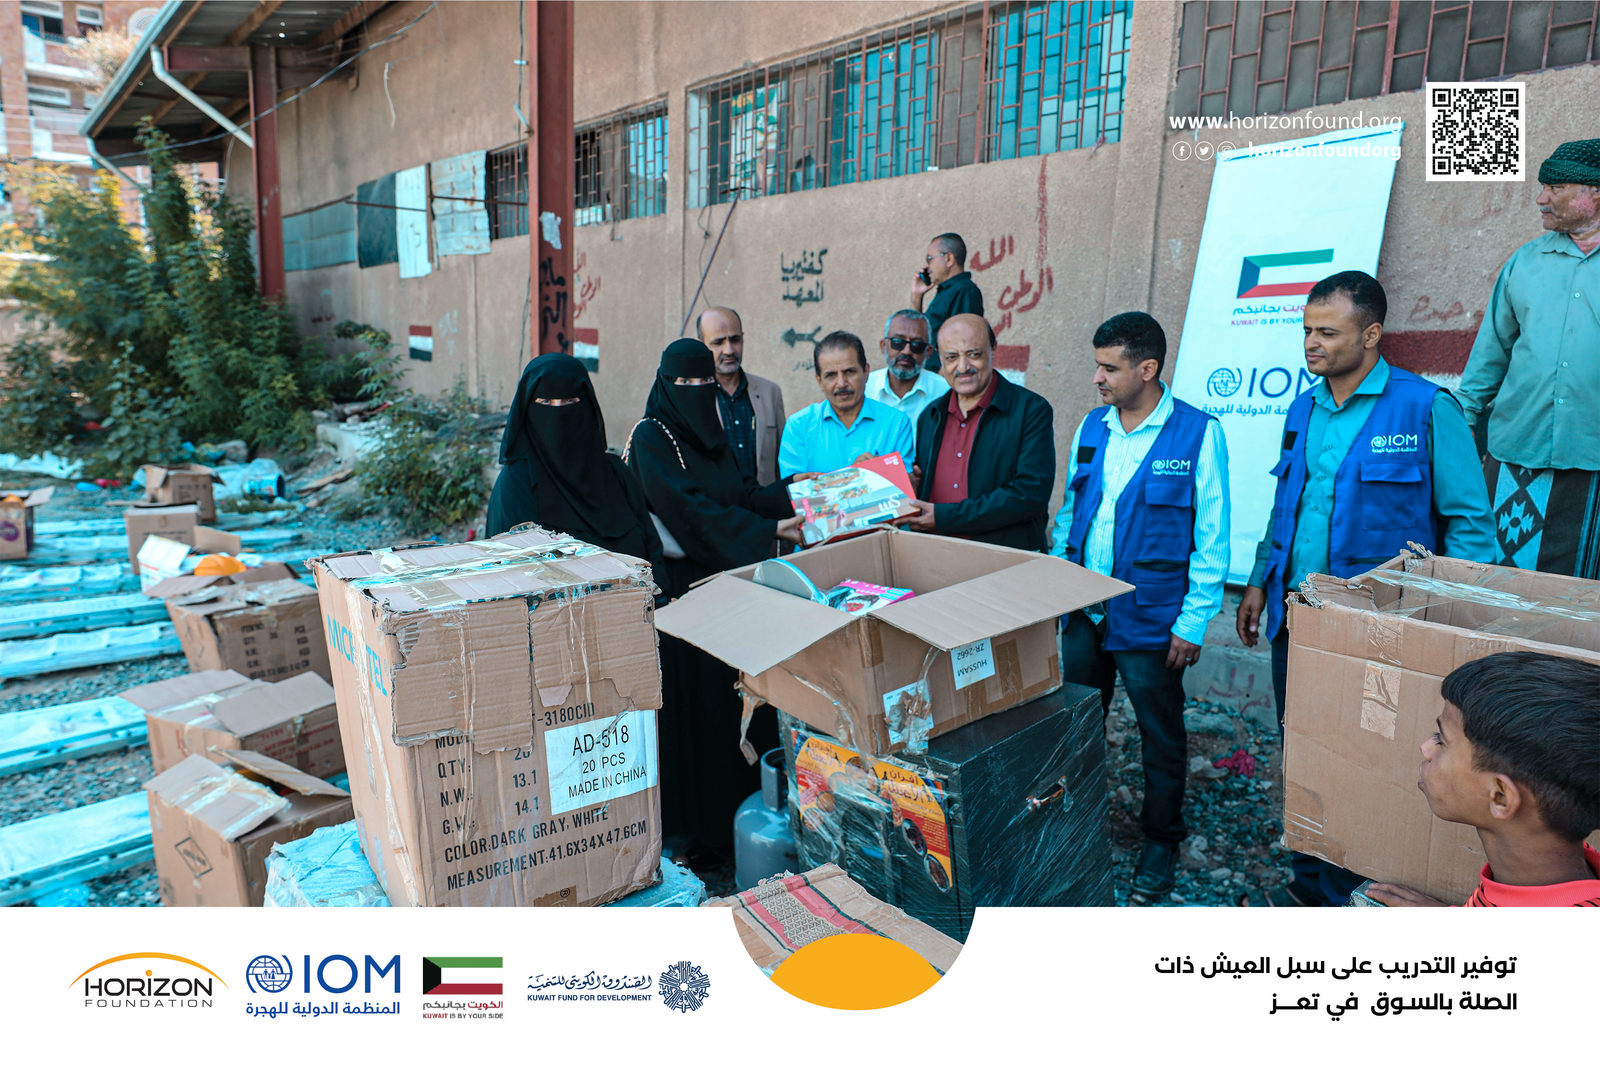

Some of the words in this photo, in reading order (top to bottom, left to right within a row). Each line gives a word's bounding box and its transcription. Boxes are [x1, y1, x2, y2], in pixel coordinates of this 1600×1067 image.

[970, 235, 1014, 271] الله
[782, 280, 824, 307] المعهد
[1233, 304, 1281, 316] بجانبكم
[1282, 317, 1303, 325] YOUR
[1248, 367, 1319, 398] IOM
[1388, 434, 1418, 446] IOM
[1166, 459, 1191, 470] IOM
[956, 642, 985, 661] ZR-2662
[957, 659, 987, 677] HUSSAM
[532, 702, 595, 727] -3180CID
[573, 725, 630, 756] AD-518
[438, 758, 471, 779] QTY:
[582, 760, 596, 774] 20
[602, 752, 626, 768] PCS
[513, 769, 537, 789] 13.1
[568, 778, 599, 799] MADE
[602, 774, 613, 789] IN
[615, 765, 647, 785] CHINA
[515, 796, 539, 816] 14.1
[572, 805, 609, 829] WHITE
